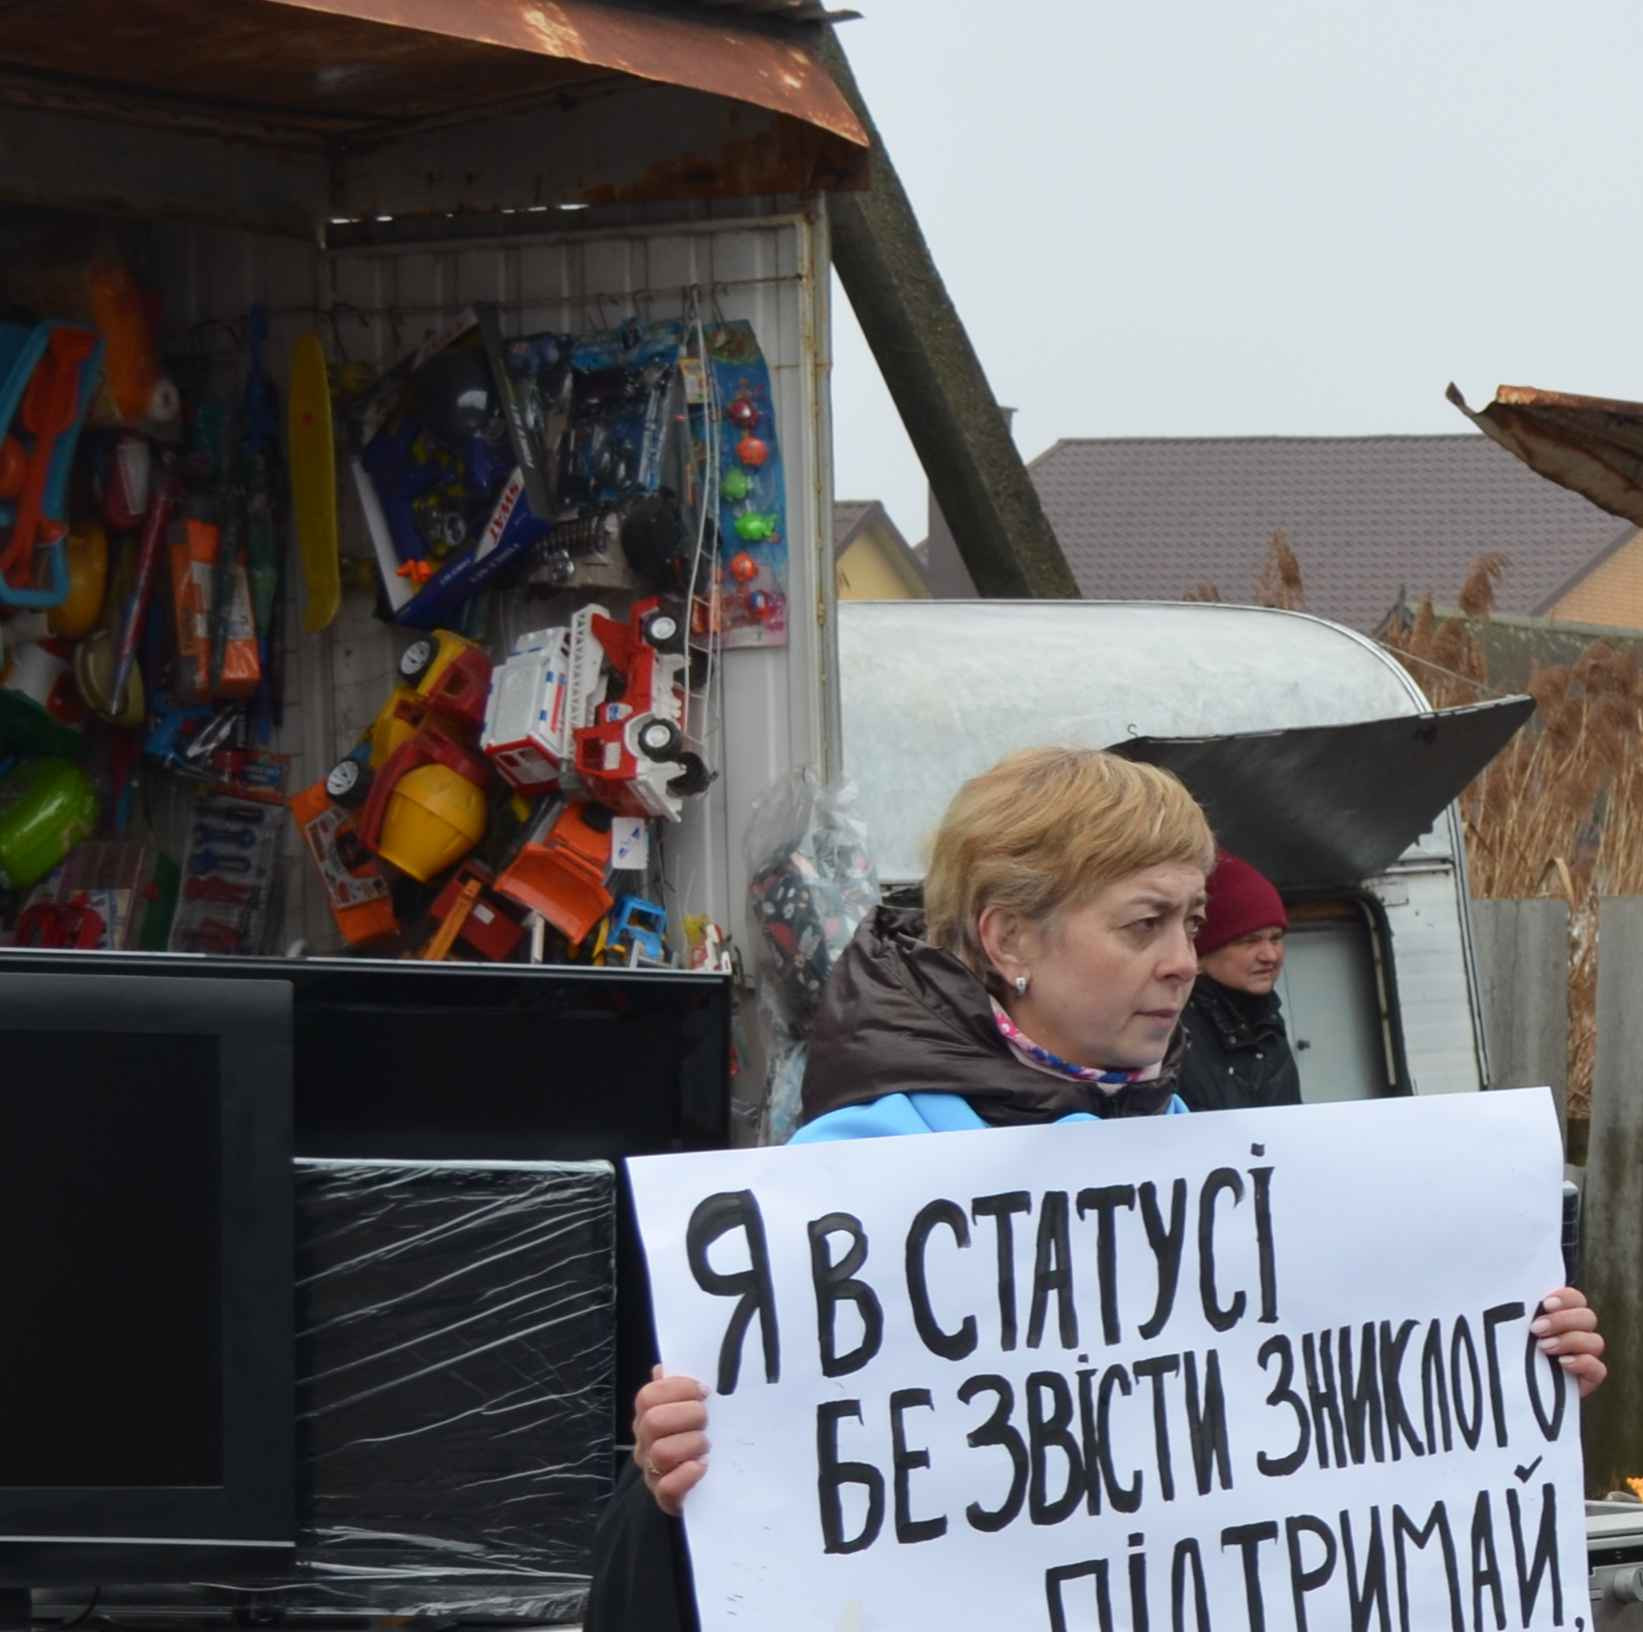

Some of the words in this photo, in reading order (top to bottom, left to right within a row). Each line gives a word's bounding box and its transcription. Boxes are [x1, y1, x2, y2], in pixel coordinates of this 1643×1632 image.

[684, 1188, 781, 1396] Я
[805, 1210, 884, 1380] В
[1254, 1300, 1567, 1479] ЗНИКЛОГО
